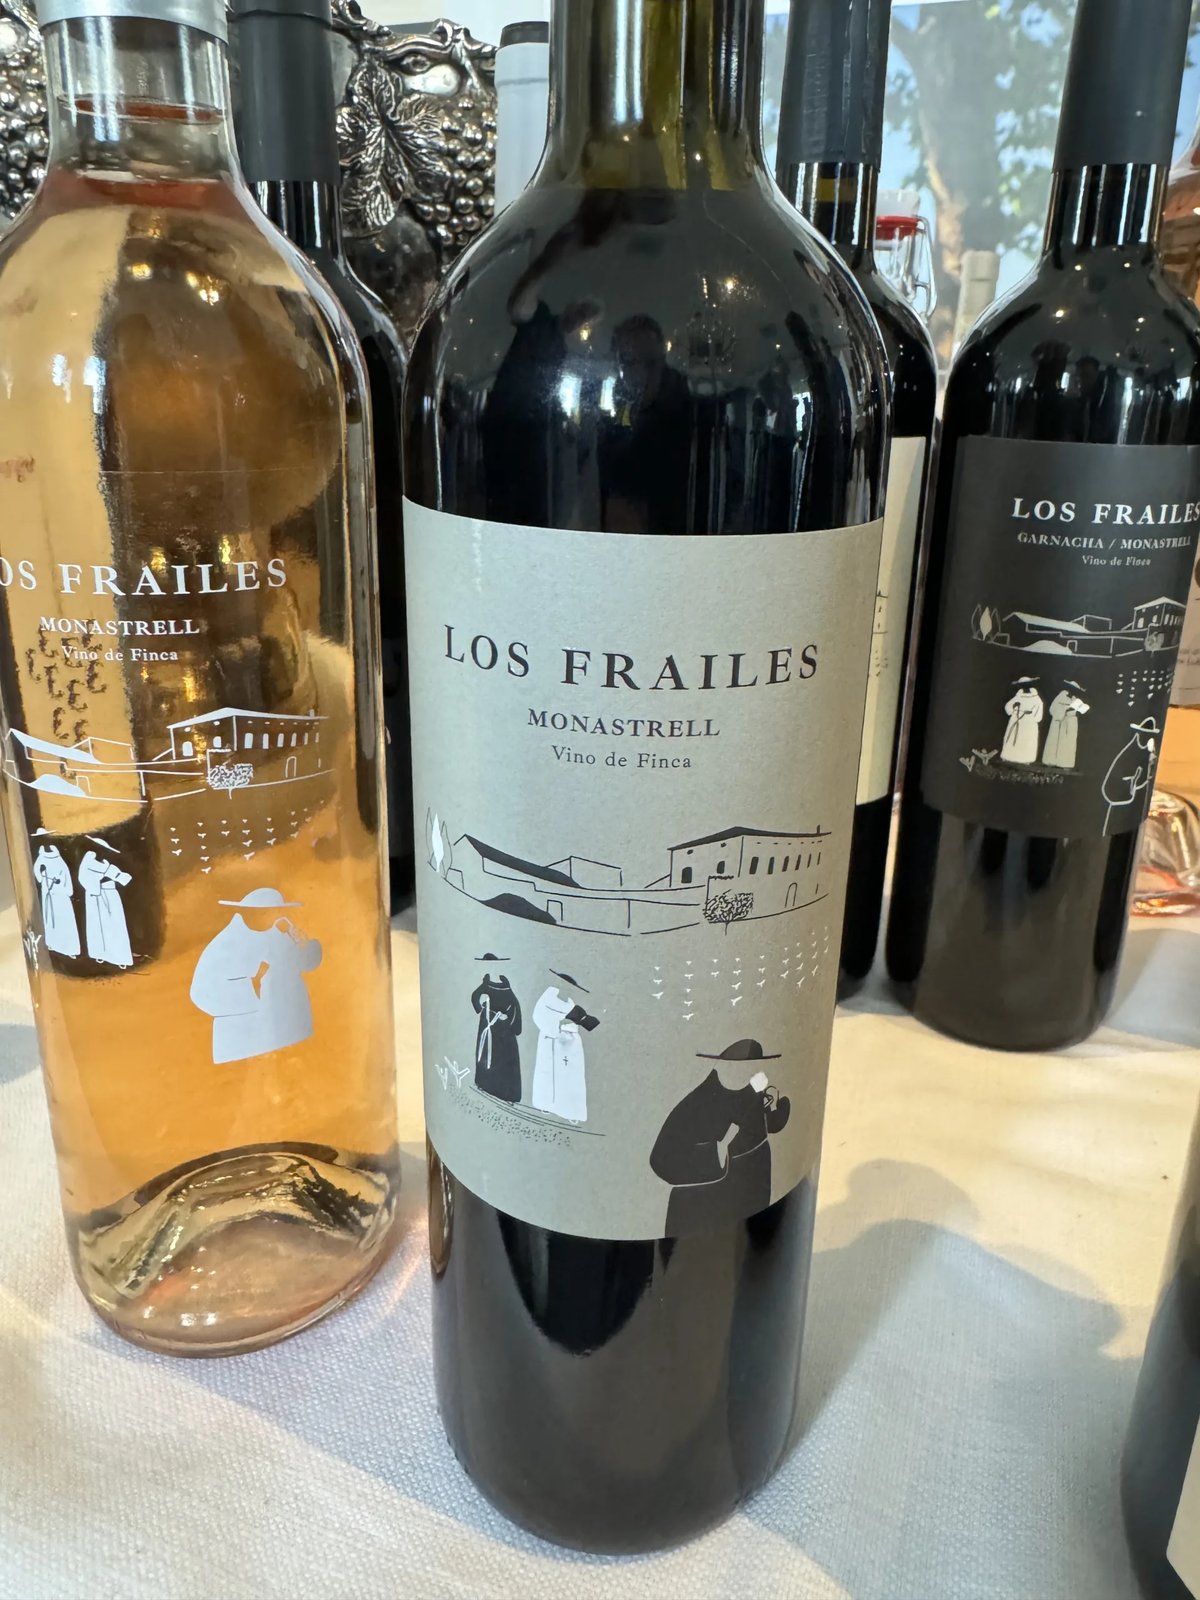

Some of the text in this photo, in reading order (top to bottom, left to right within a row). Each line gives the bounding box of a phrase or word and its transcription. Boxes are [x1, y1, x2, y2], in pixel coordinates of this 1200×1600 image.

[1011, 497, 1200, 525] LOS FRAILES
[1017, 531, 1103, 549] GARNACHA
[1120, 535, 1191, 549] MONASTRELL
[1082, 555, 1151, 566] Vino de Finca
[0, 557, 287, 596] OS FRAILES
[40, 616, 200, 636] MONASTRELL
[61, 645, 178, 661] Vino de Finca
[443, 624, 818, 691] LOS FRAILES
[527, 708, 721, 738] MONASTRELL
[551, 745, 691, 769] Vino de Finca
